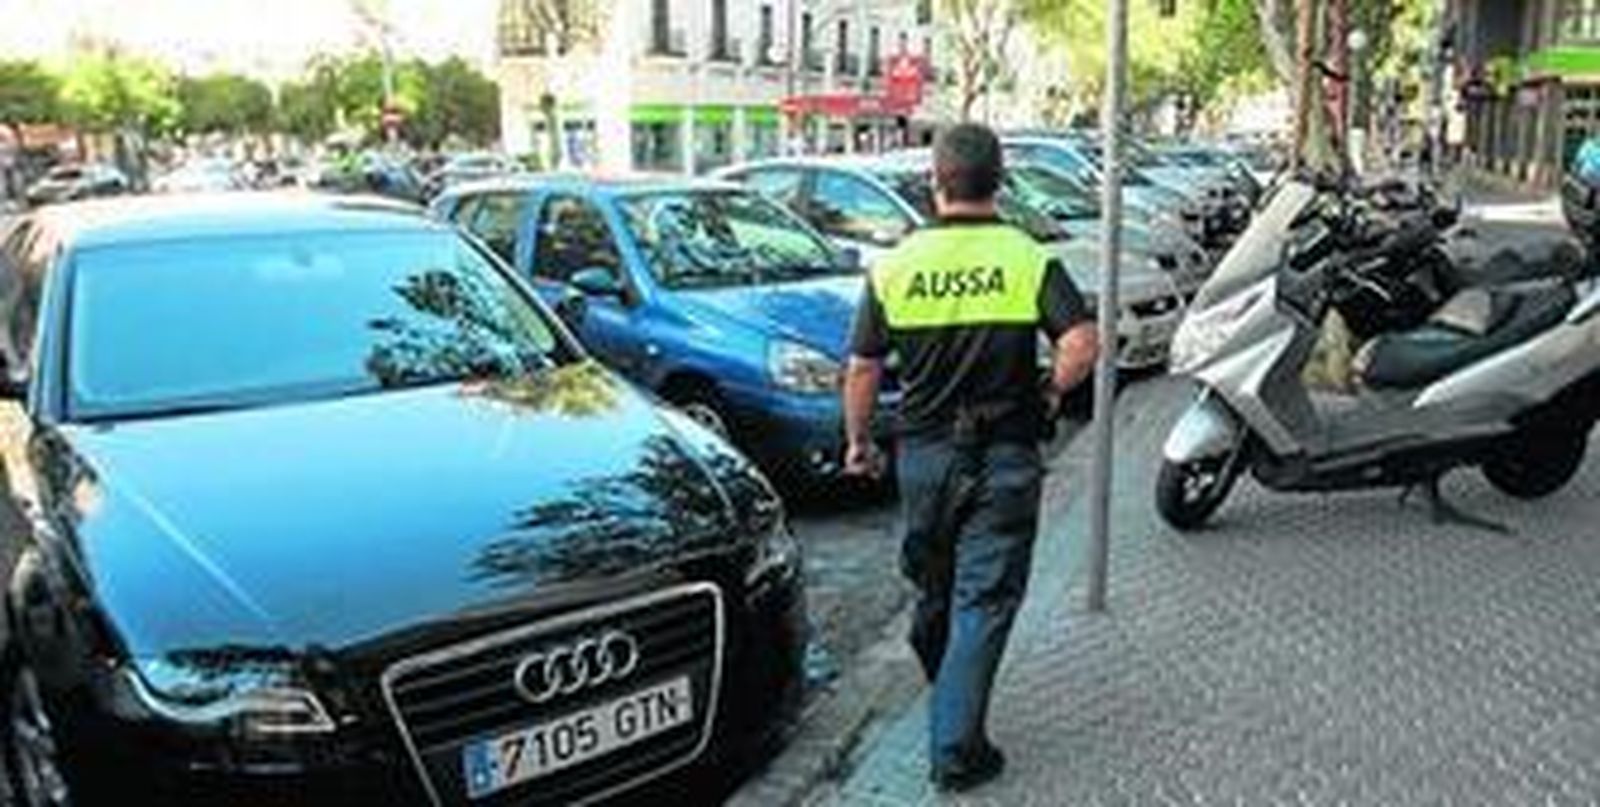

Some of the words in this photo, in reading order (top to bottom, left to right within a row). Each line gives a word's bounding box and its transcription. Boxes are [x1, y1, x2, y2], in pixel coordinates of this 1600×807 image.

[905, 266, 1005, 299] AUSSA
[503, 713, 598, 778] 7105
[615, 687, 677, 739] GTN
